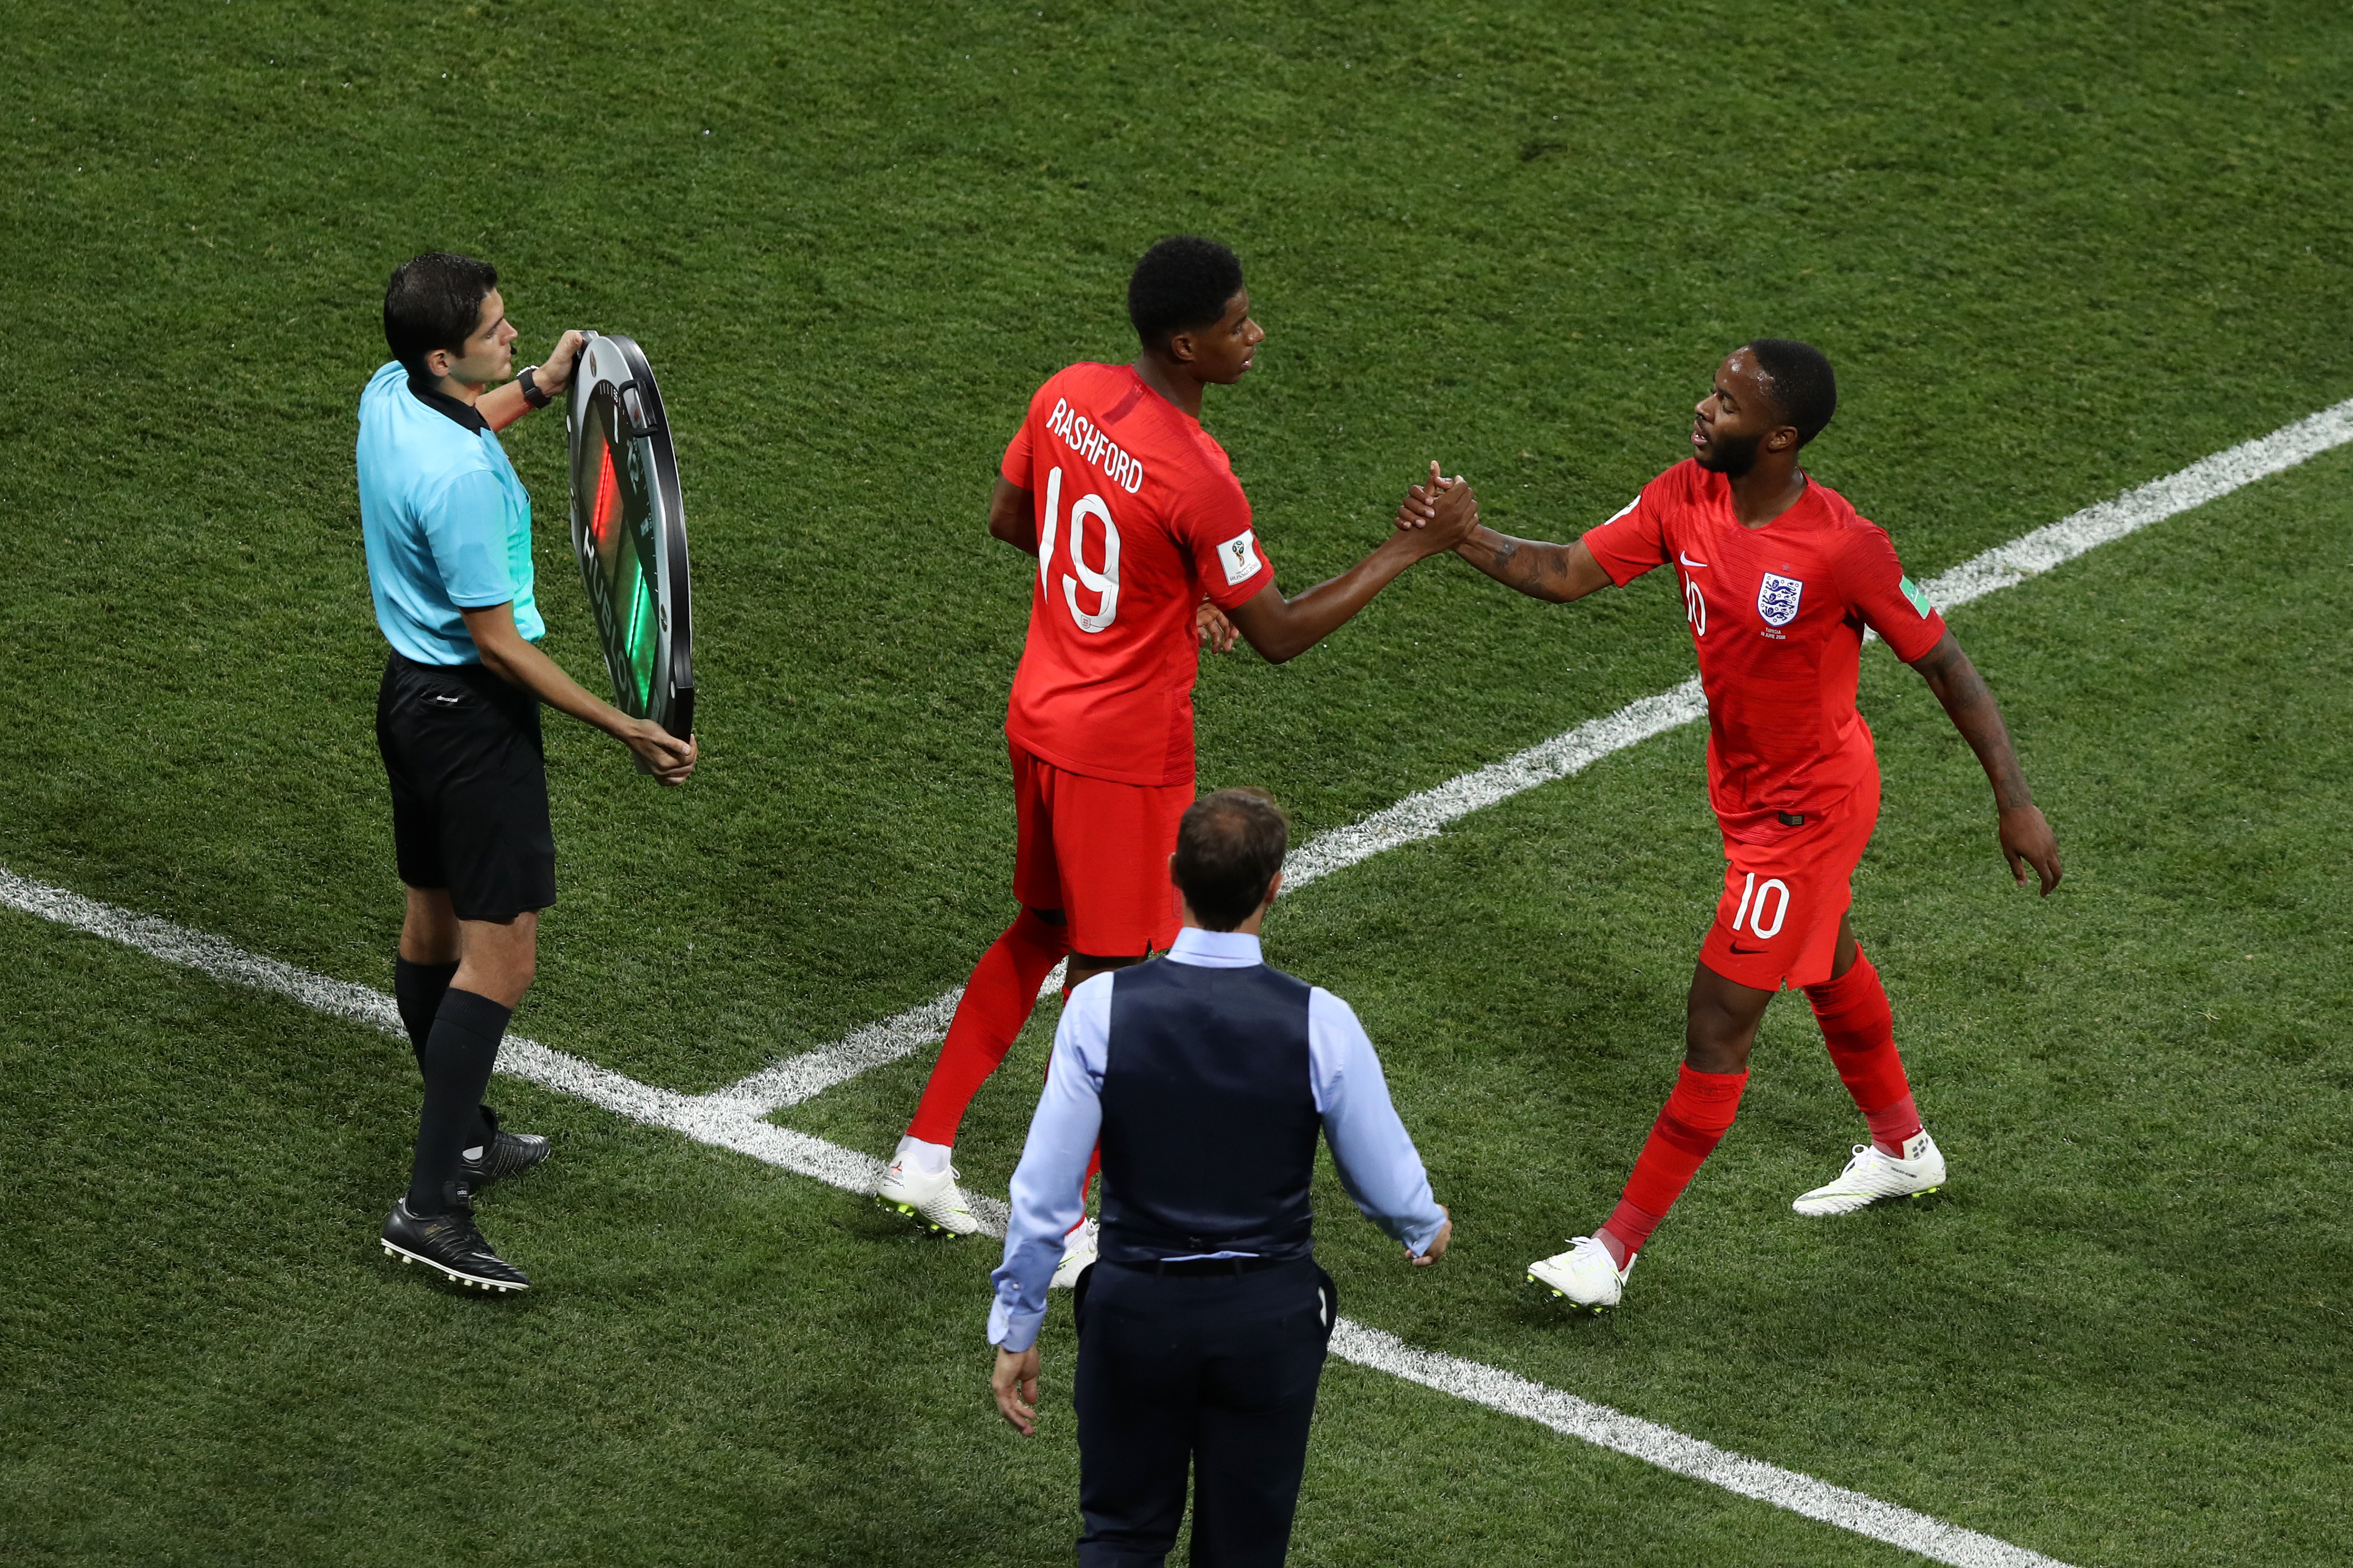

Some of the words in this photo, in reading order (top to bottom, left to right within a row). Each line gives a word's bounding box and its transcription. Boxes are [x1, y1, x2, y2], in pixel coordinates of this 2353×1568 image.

[1046, 397, 1143, 494] RASHFORD
[1039, 466, 1120, 633] 19
[1230, 570, 1249, 581] RUSSIA
[1249, 561, 1259, 571] 2018
[584, 525, 635, 714] HUBLOT
[1685, 570, 1706, 636] 10
[1733, 872, 1790, 939] 10
